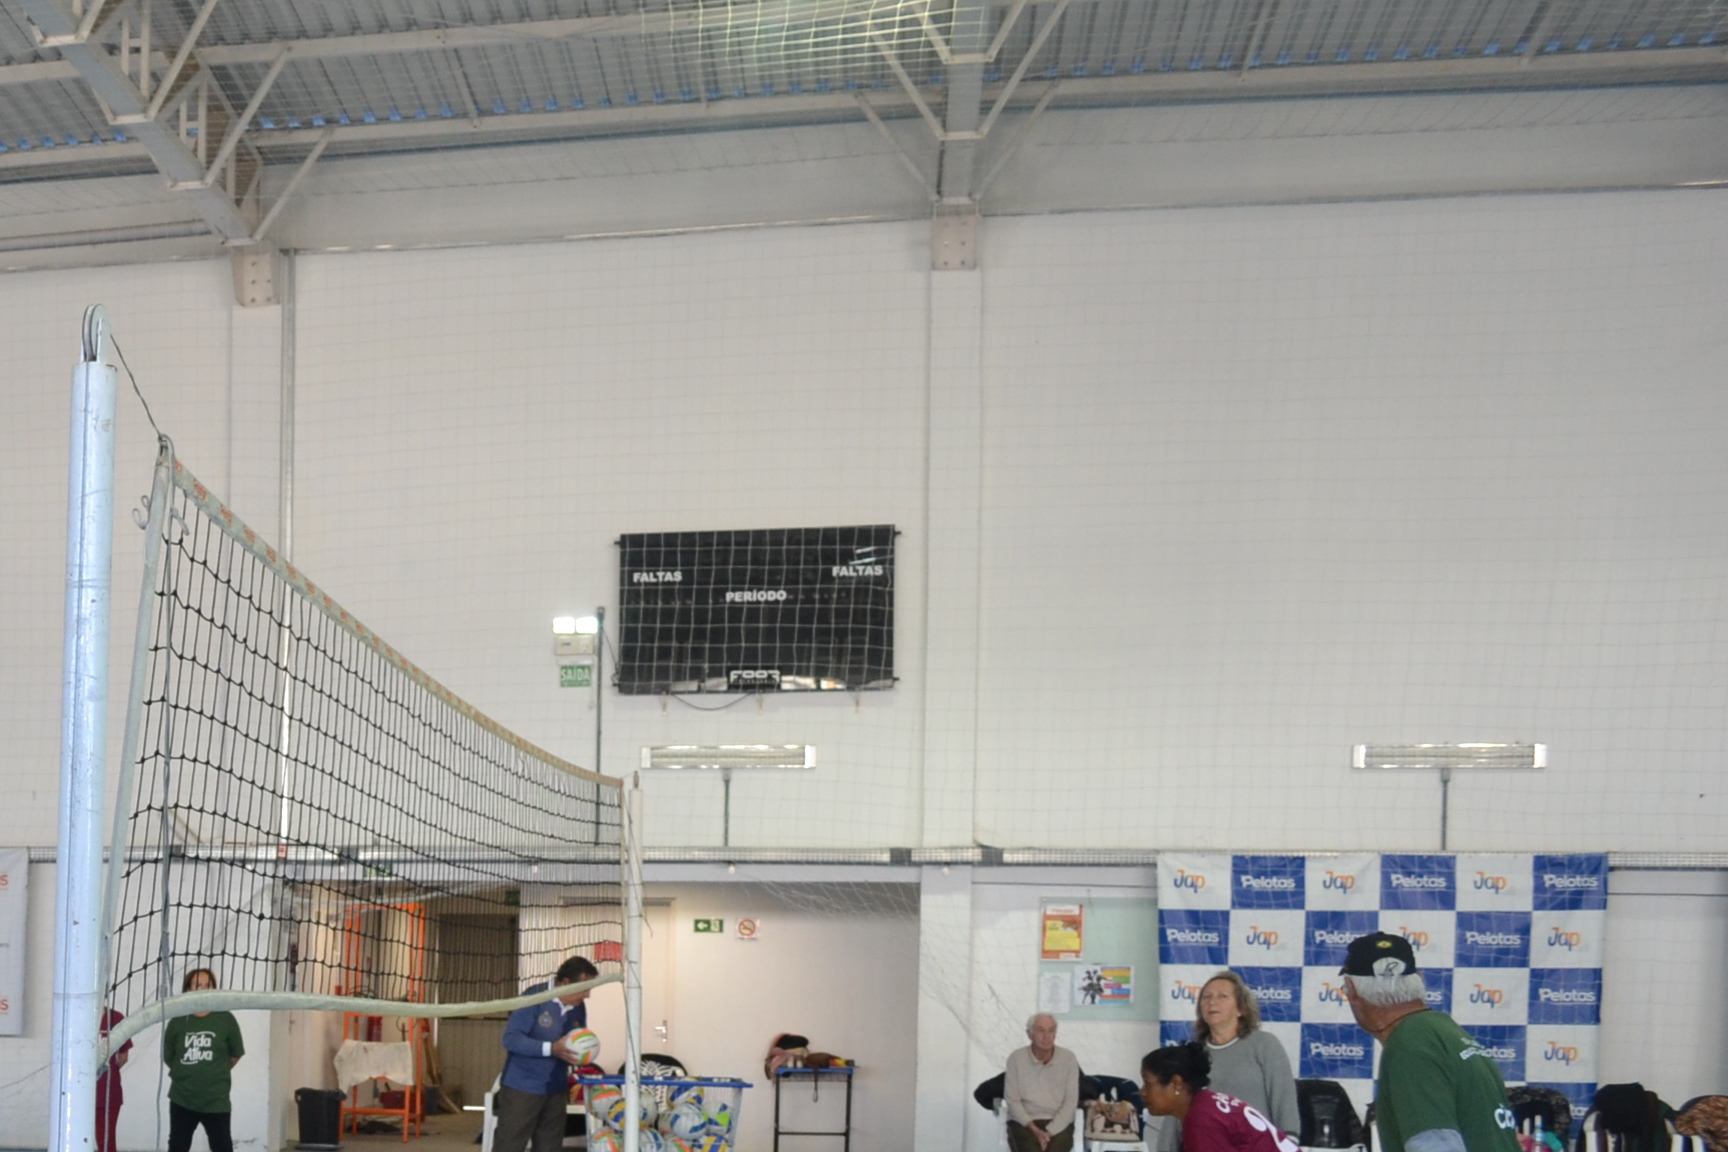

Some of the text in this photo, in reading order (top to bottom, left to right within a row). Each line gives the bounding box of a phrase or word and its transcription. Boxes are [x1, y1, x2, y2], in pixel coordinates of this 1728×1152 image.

[633, 571, 682, 583] FALTAS
[832, 565, 883, 577] FALTAS
[725, 588, 787, 602] PERÍODO
[1174, 869, 1206, 893] Jap
[1240, 875, 1295, 888] Pelotas
[1322, 870, 1355, 894] Jap
[1390, 873, 1446, 888] Pelotas
[1474, 871, 1506, 894] Jap
[1543, 874, 1598, 888] Pelotas
[1166, 928, 1219, 943] Pelotas
[1246, 925, 1278, 950] Jap
[1465, 931, 1521, 945] Pelotas
[1547, 926, 1581, 950] Jap
[1250, 986, 1292, 1000] elotas
[1469, 984, 1503, 1008] Jap
[1538, 988, 1596, 1002] Pelotas
[184, 1034, 212, 1048] Vida
[183, 1047, 213, 1061] Ativa
[1310, 1042, 1365, 1056] Pelotas
[1544, 1041, 1579, 1066] Jap
